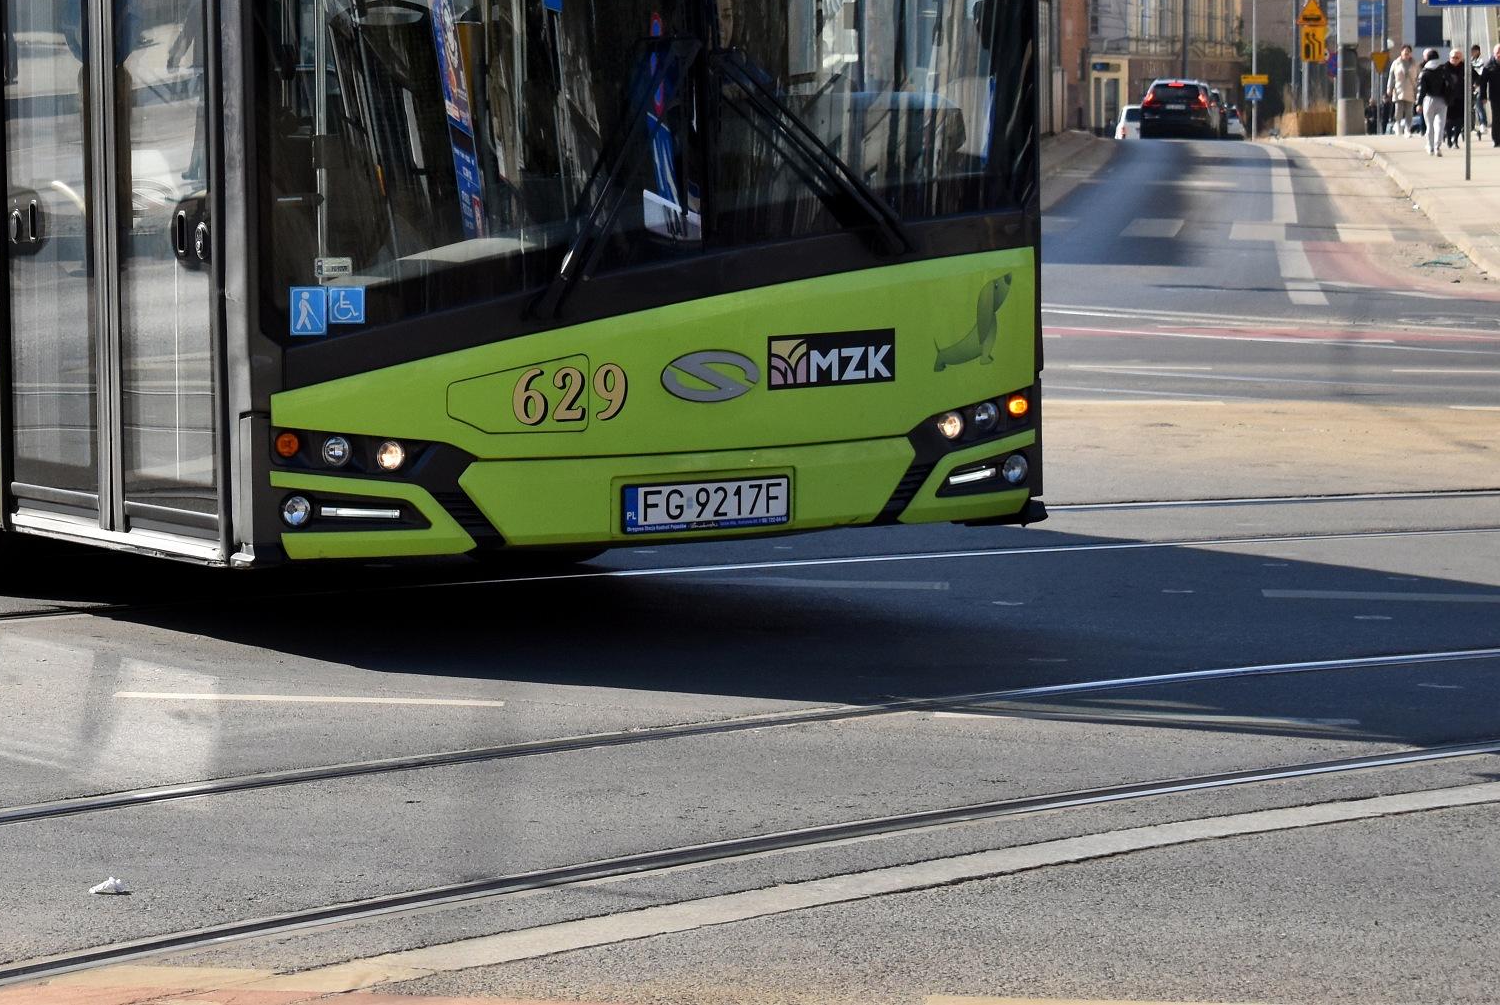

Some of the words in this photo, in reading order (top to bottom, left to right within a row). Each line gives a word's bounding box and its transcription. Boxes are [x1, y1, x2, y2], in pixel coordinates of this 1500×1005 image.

[809, 344, 892, 383] MZK
[512, 362, 628, 426] 629
[626, 511, 637, 520] PL
[643, 488, 684, 522] FG
[695, 482, 783, 519] 9217F
